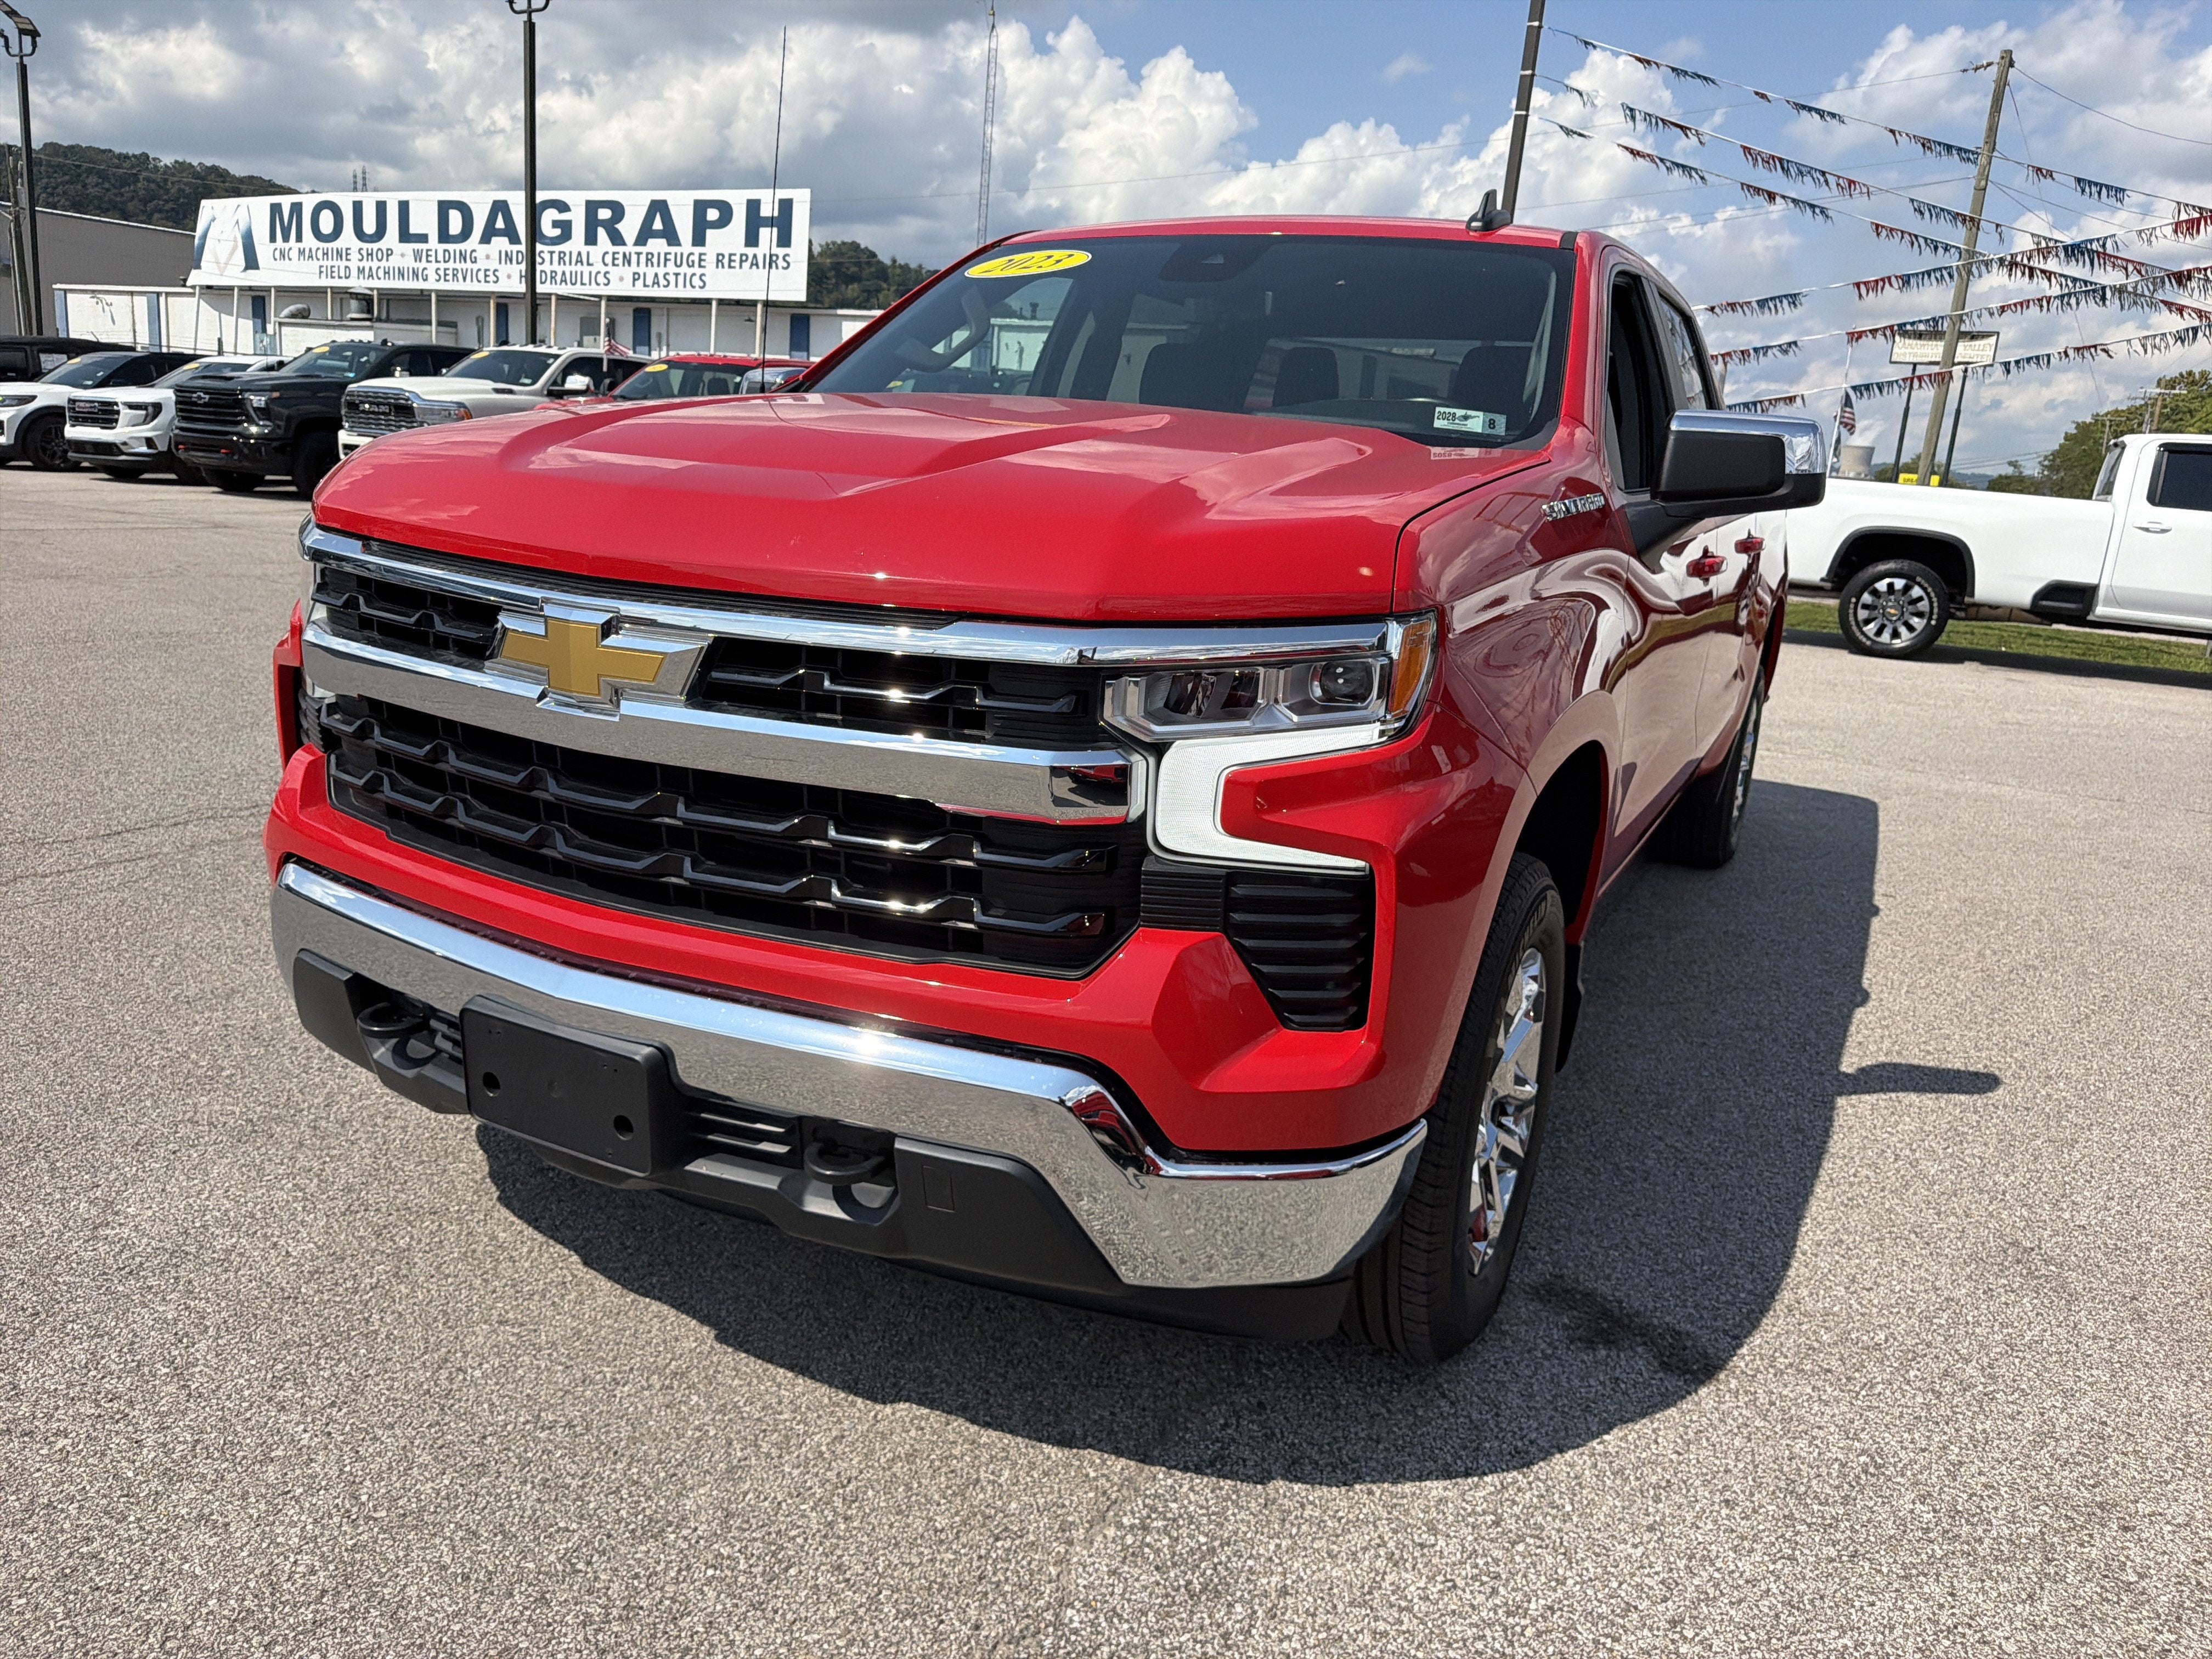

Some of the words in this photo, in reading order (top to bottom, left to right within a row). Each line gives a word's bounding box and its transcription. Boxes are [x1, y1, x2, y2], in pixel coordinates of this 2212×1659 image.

[269, 198, 794, 248] MOULDAGRAPH
[273, 247, 292, 262] CNC
[298, 247, 352, 262] MACHINE
[358, 248, 393, 262] SHOP
[413, 249, 477, 264] WELDING
[499, 250, 594, 267] INDSTRIAL
[602, 251, 707, 269] CENTRIFUGE
[715, 252, 791, 270] REPAIRS
[978, 253, 1076, 274] 2023
[319, 265, 352, 279] FIELD
[357, 266, 428, 282] MACHINING
[435, 268, 500, 284] SERVICES
[519, 269, 611, 287] HDRAULICS
[633, 272, 707, 289] PLASTICS
[1436, 410, 1457, 421] 2028
[1488, 418, 1496, 430] 8
